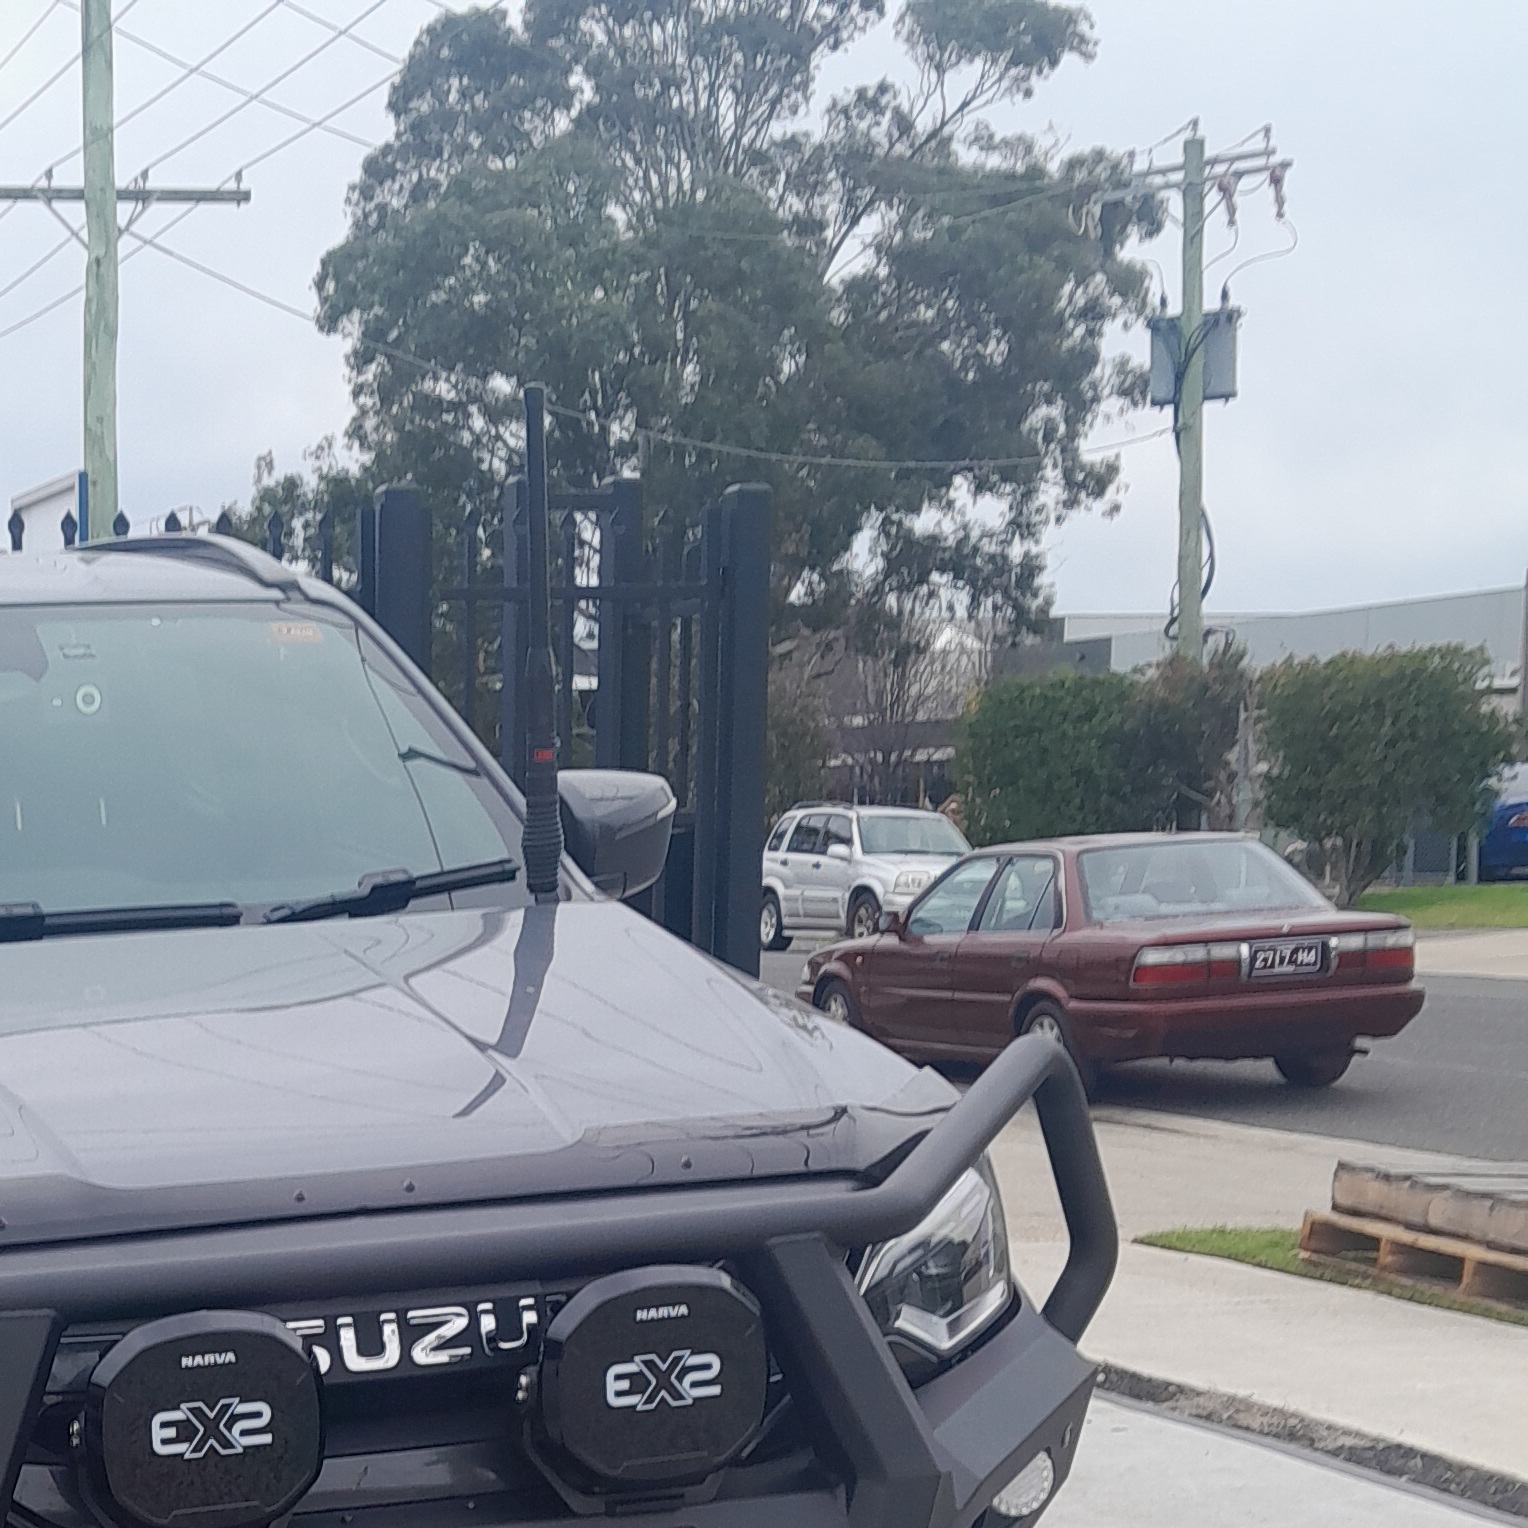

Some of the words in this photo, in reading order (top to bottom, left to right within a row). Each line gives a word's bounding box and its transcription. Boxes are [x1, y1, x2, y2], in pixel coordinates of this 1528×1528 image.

[636, 1303, 689, 1321] NARVA
[181, 1351, 237, 1369] NARVA
[605, 1348, 722, 1412] EX2
[152, 1397, 273, 1460] EX2
